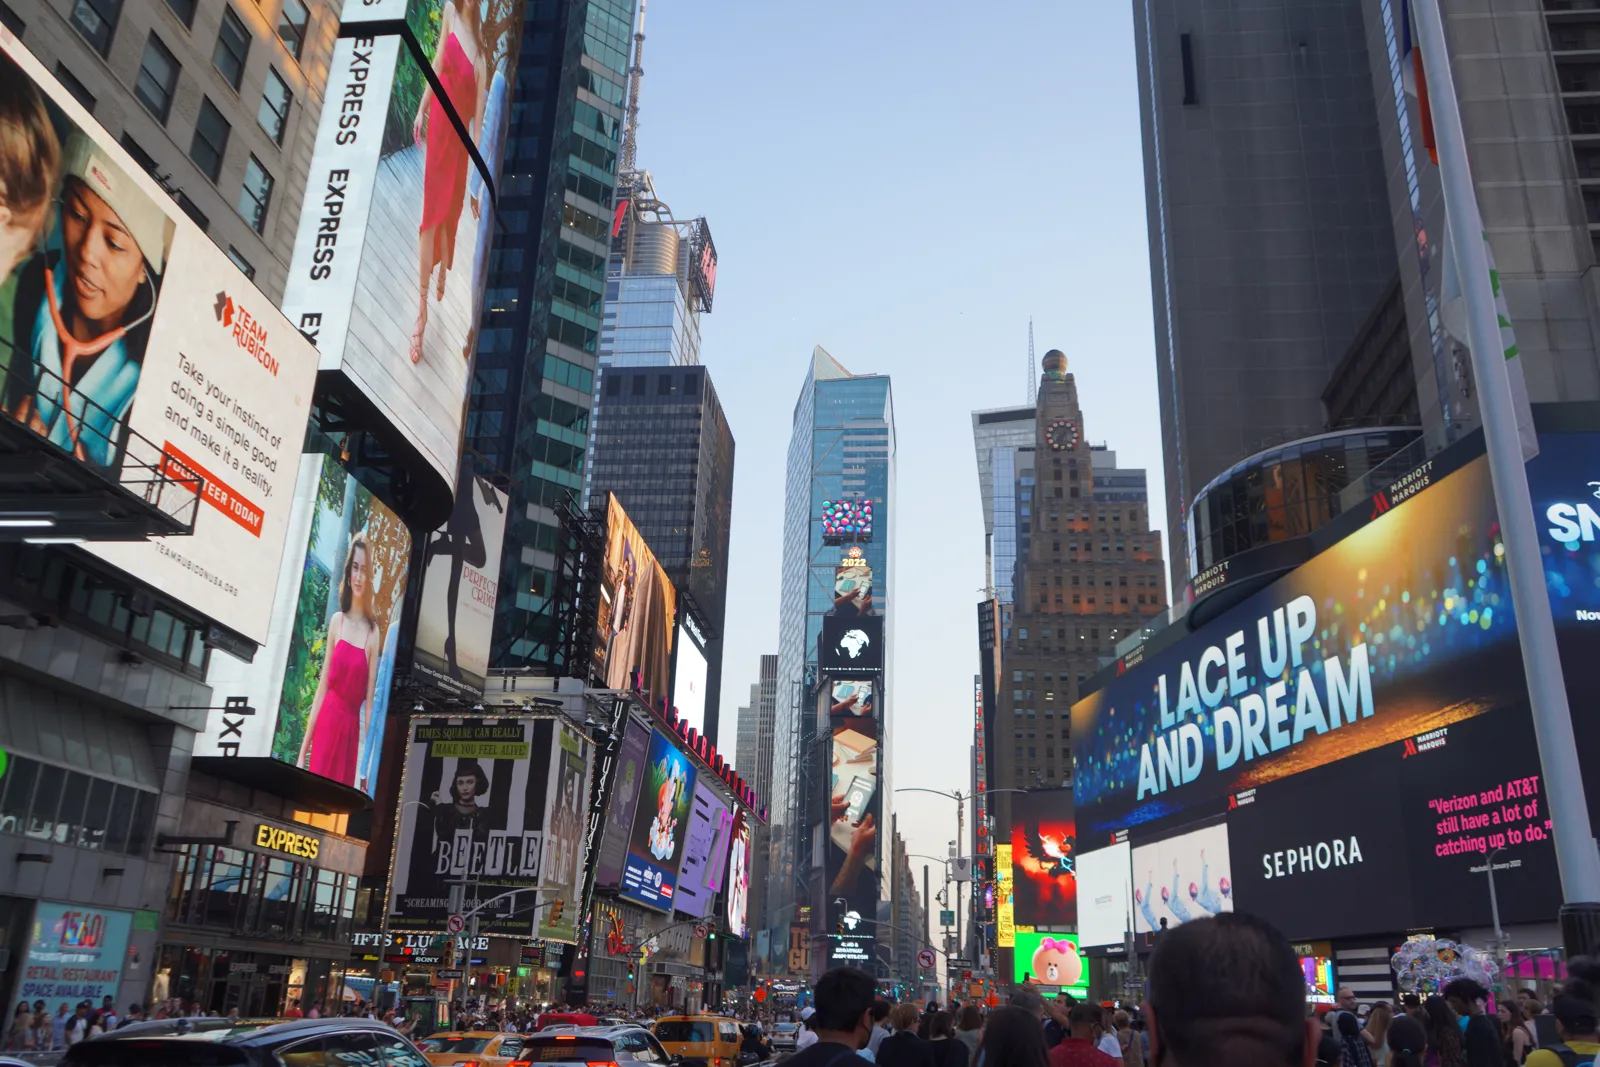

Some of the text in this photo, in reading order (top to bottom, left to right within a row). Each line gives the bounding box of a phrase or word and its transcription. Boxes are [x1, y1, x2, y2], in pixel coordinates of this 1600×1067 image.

[335, 36, 375, 146] EXPRESS
[309, 169, 350, 281] EXPRESS
[237, 305, 268, 346] TEAM
[231, 324, 280, 377] RUBICON
[178, 352, 282, 450] Take your instinct of
[171, 380, 277, 473] doing a simple good
[165, 405, 273, 497] and make it a reality.
[166, 452, 260, 528] VOLUTEER TODAY
[1391, 461, 1433, 493] MARRIOTT
[1391, 475, 1430, 505] MARQUIS
[155, 541, 239, 598] TEAMRUBICONUSA.ORG
[842, 558, 866, 567] 2022
[1194, 561, 1229, 586] MARRIOTT
[463, 566, 497, 596] PERFECT
[471, 586, 496, 610] CRIME
[1195, 574, 1225, 597] MARQUIS
[1157, 594, 1317, 731] LACE UP
[418, 727, 522, 740] TIMES SQUARE CAN REALLY
[663, 697, 698, 750] 1540
[1136, 642, 1376, 801] AND DREAM
[1417, 728, 1448, 743] MARRIOTT
[435, 743, 459, 755] MAKE
[460, 744, 477, 755] YOU
[478, 744, 498, 755] FEEL
[1417, 738, 1446, 751] MARQUIS
[1479, 784, 1504, 805] and
[1506, 775, 1539, 800] AT&T
[1436, 799, 1538, 836] still have a lot of
[256, 824, 320, 860] EXPRESS
[435, 829, 542, 877] BEETLE
[1263, 835, 1364, 880] SEPHORA
[1435, 834, 1487, 857] catching
[1488, 832, 1506, 850] up
[1507, 828, 1523, 845] to
[346, 933, 489, 950] IFTS LUAGE
[21, 983, 104, 999] SPACE AVAILABLE
